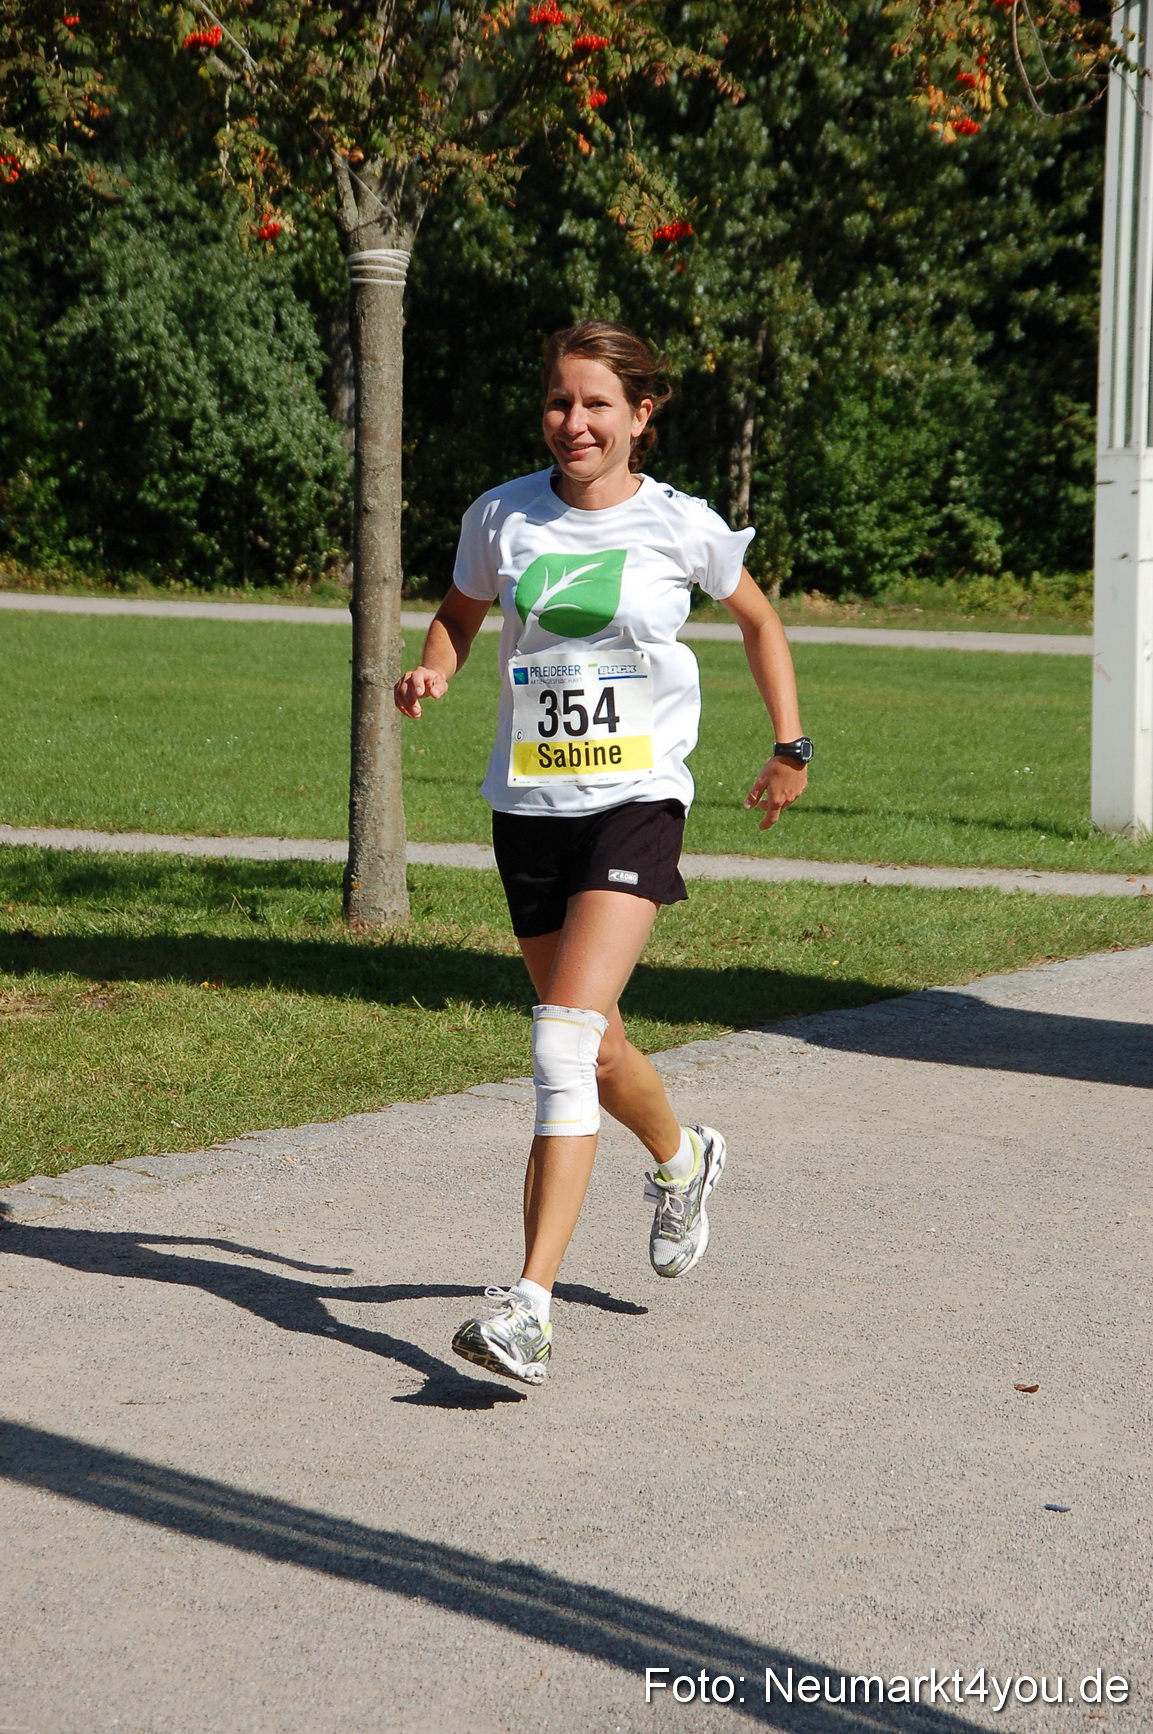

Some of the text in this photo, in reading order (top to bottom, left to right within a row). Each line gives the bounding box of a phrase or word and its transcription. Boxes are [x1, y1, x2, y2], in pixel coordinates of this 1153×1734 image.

[530, 665, 582, 678] PFLEIDERER
[598, 665, 637, 675] BOCK
[538, 686, 620, 738] 354
[538, 742, 622, 768] Sabine
